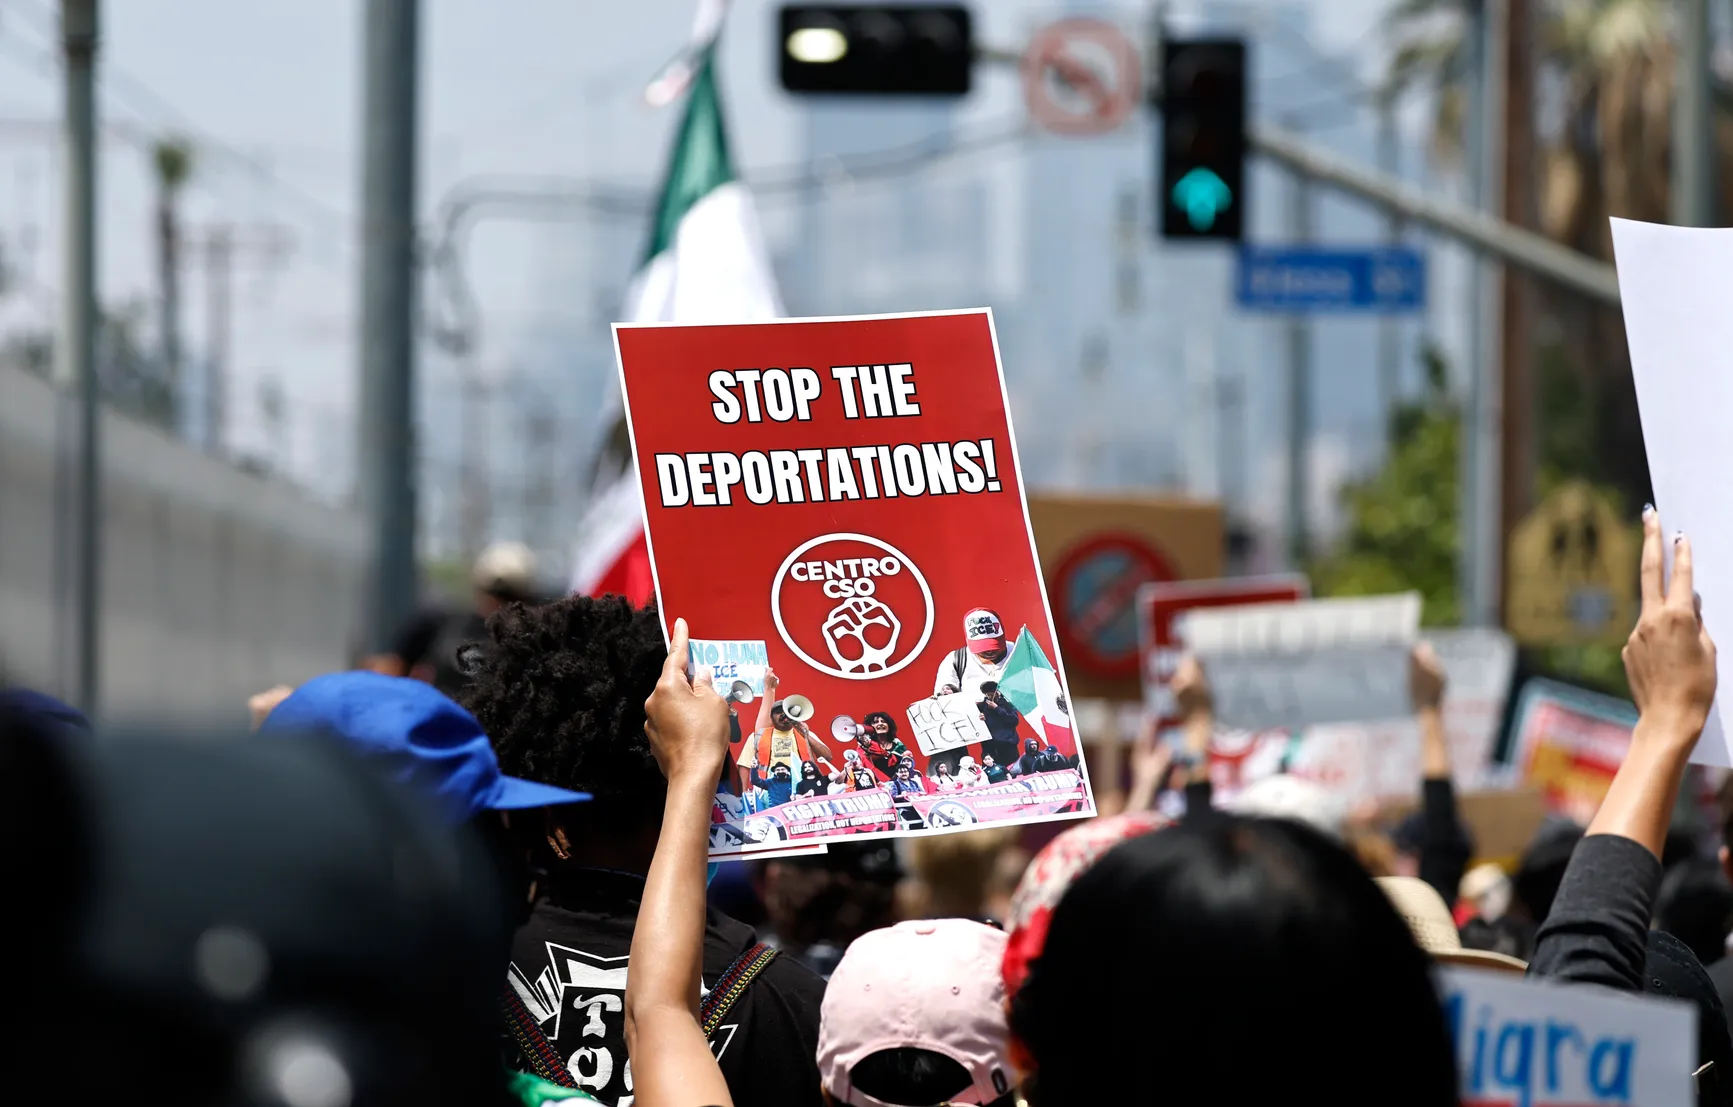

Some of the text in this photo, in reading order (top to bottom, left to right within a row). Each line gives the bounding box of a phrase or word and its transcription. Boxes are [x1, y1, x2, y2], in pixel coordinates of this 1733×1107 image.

[708, 362, 922, 424] STOP THE
[654, 438, 1003, 508] DEPORTATIONS!
[790, 556, 901, 582] CENTRO
[823, 577, 876, 599] CSO
[969, 622, 1000, 638] ICE!
[688, 641, 719, 666] NO
[712, 664, 738, 679] ICE
[917, 713, 981, 752] ICE!
[1023, 772, 1080, 792] TRUMP
[780, 800, 834, 821] FIGHT
[832, 791, 894, 816] TRUMP
[1444, 992, 1638, 1107] igra
